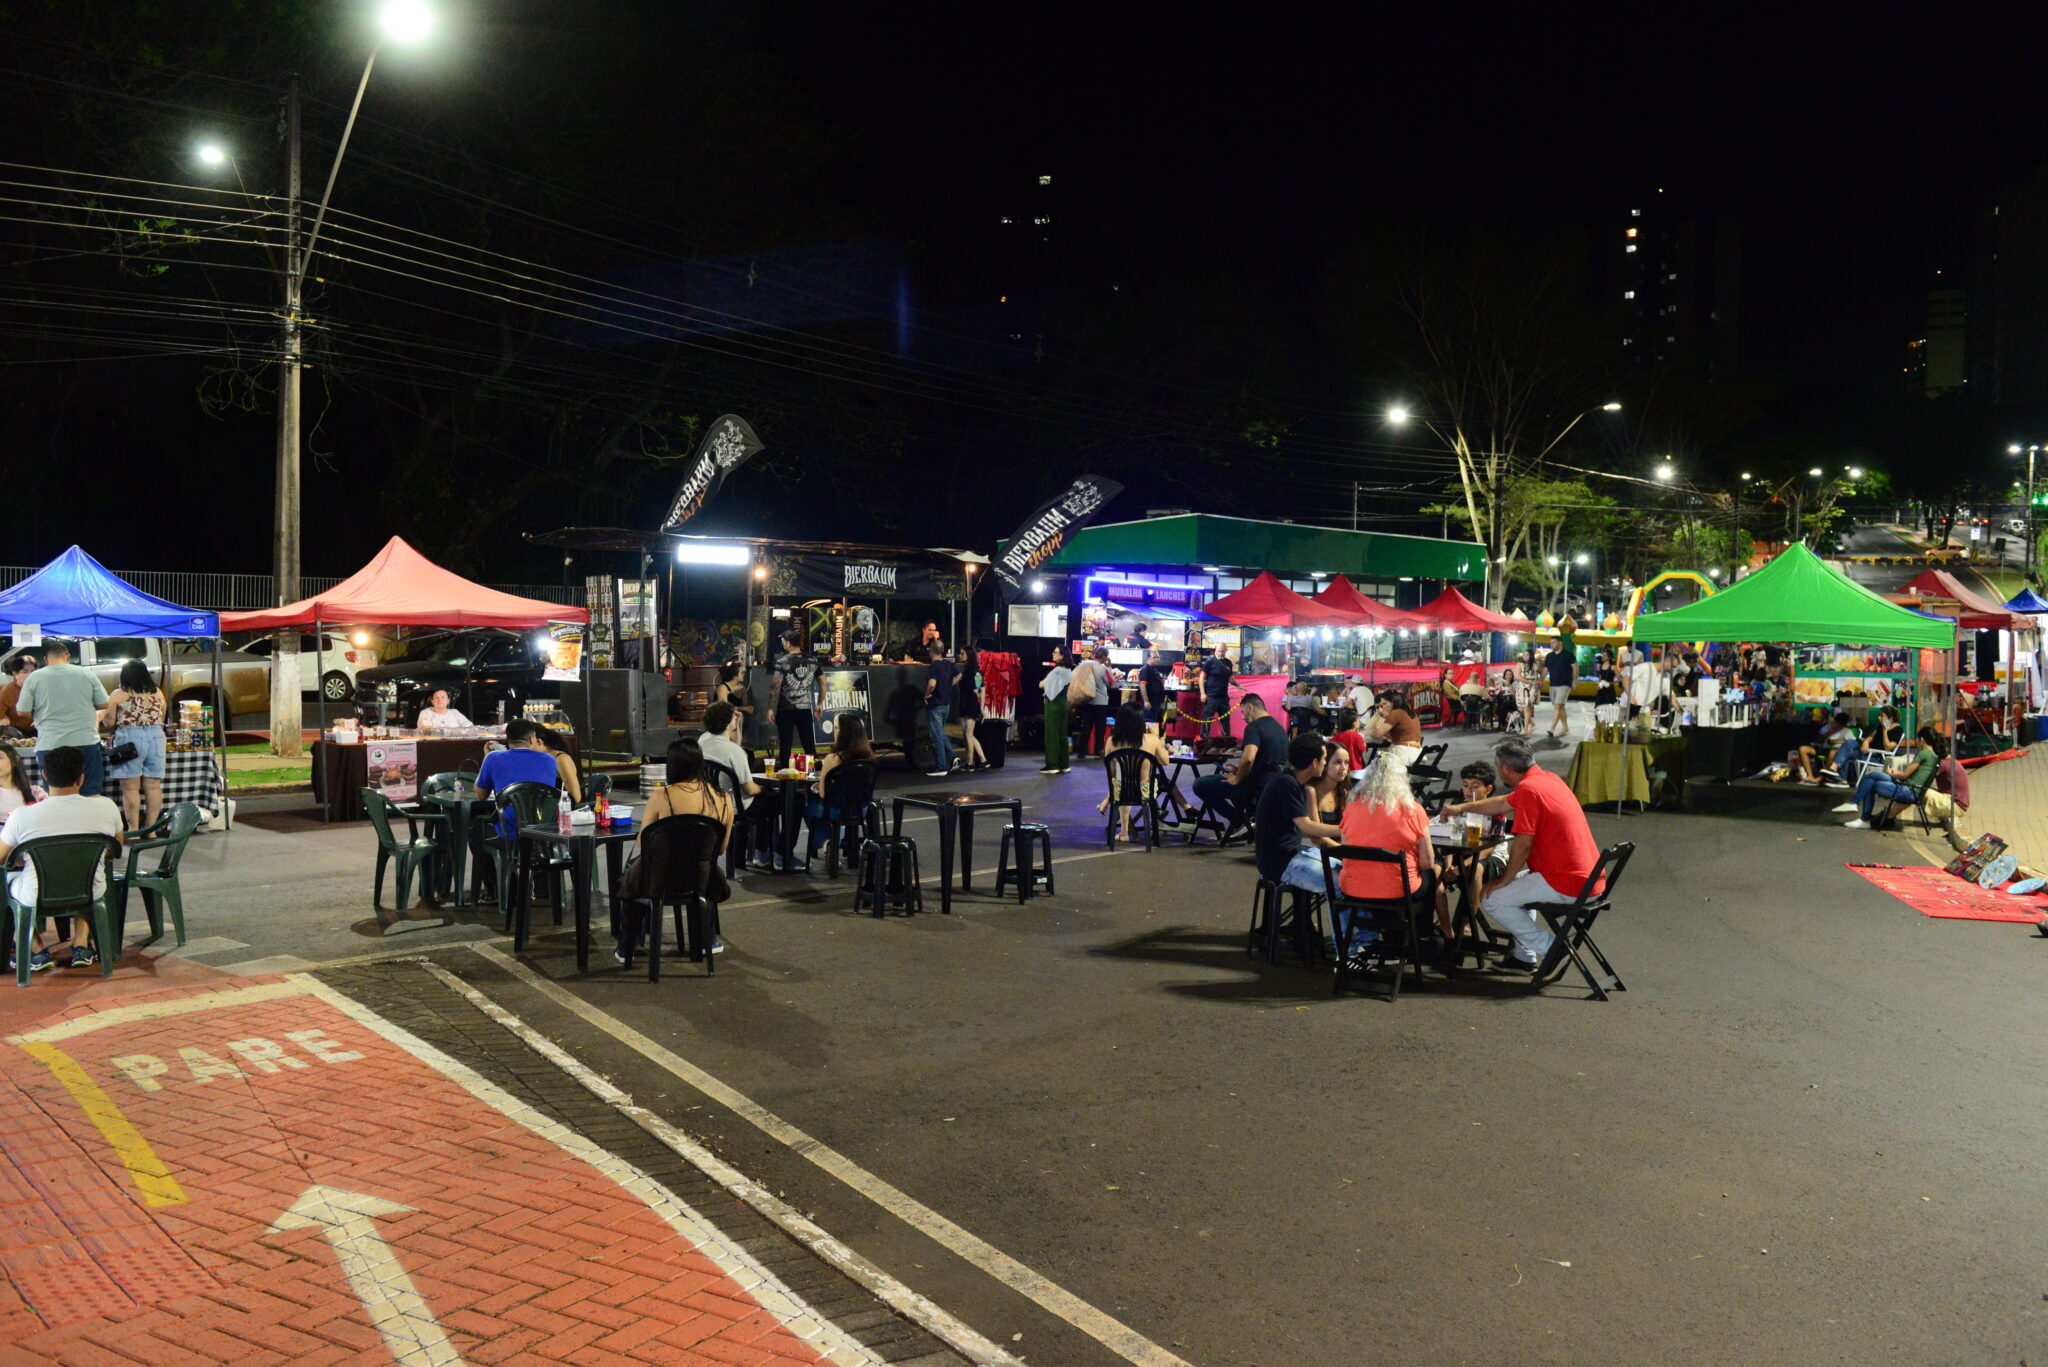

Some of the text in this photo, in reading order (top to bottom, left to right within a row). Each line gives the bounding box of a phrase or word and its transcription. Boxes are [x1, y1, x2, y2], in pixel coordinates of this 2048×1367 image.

[1002, 507, 1071, 575] BIERBAUM
[1027, 530, 1063, 569] chopp
[844, 565, 897, 590] BIERBAUM
[1108, 586, 1186, 601] MURALHA LANCHES
[110, 1028, 367, 1092] PARE
